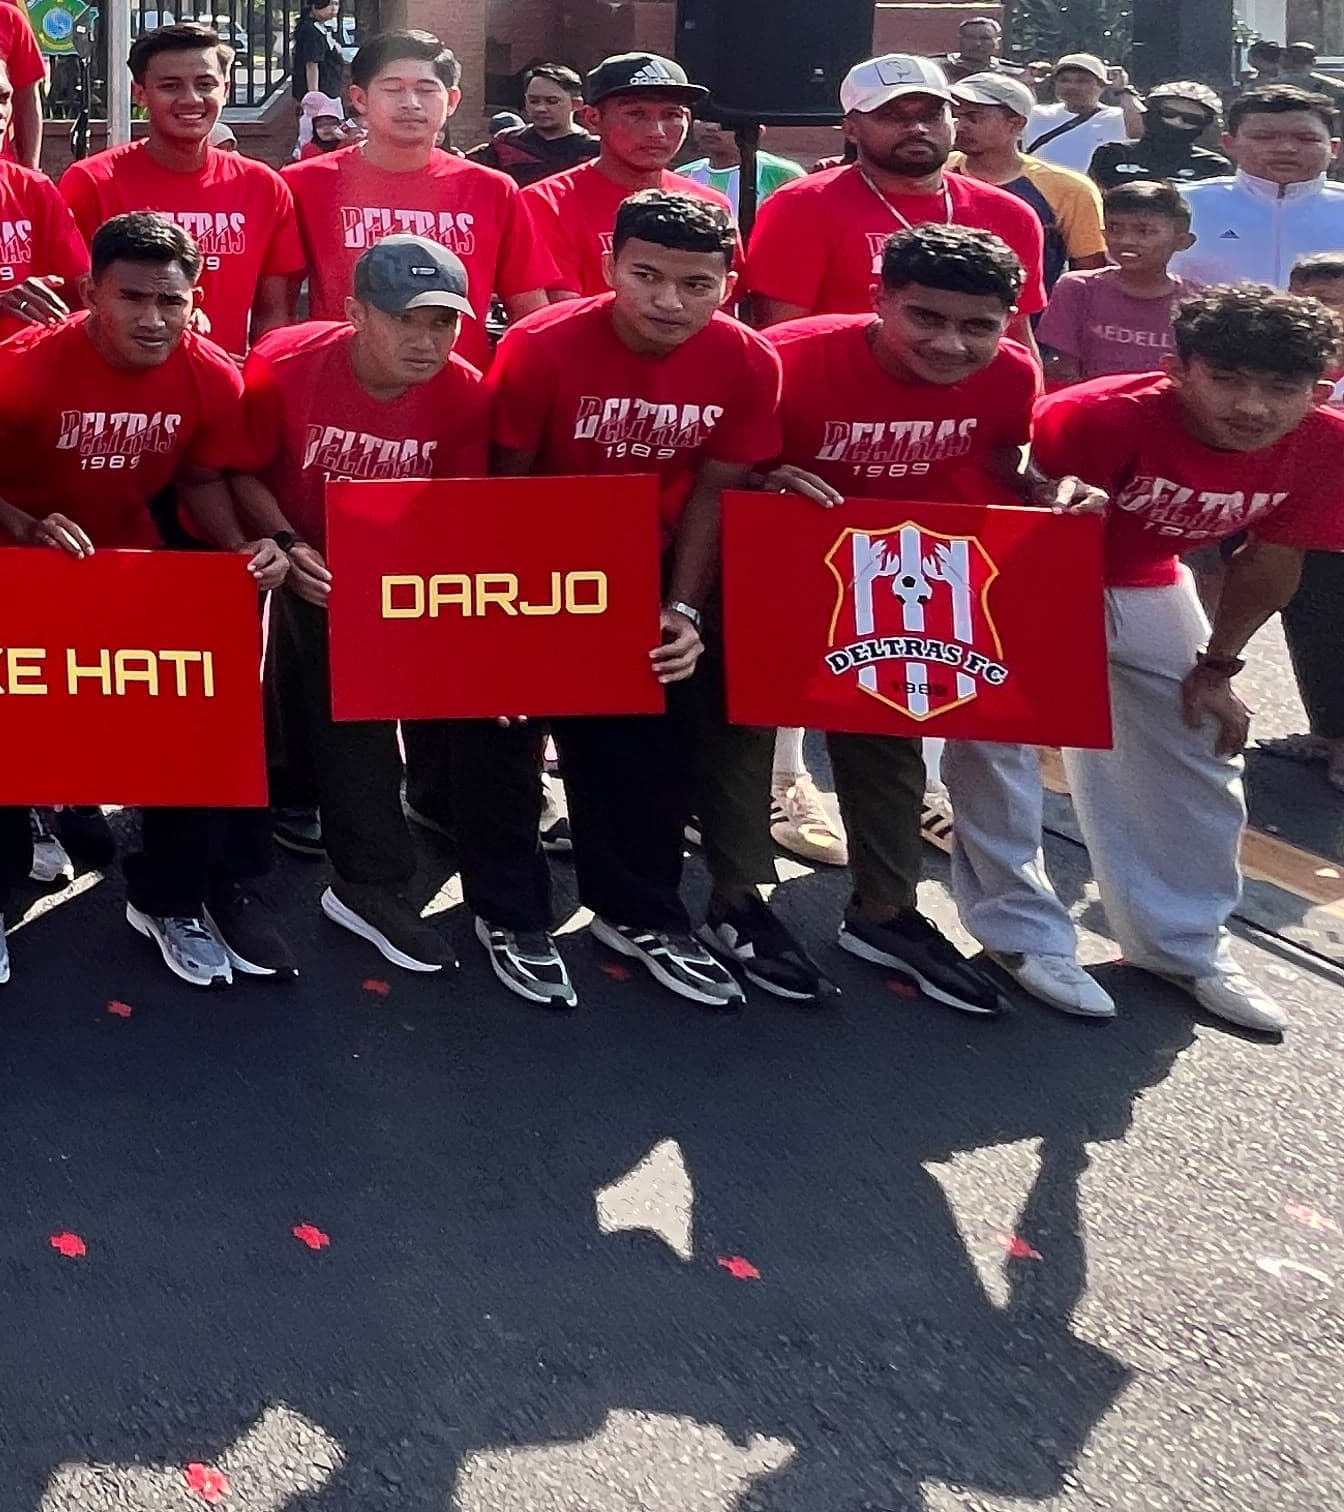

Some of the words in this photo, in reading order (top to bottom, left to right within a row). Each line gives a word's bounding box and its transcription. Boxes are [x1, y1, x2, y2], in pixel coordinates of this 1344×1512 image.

[56, 409, 181, 455] DELTRAS
[574, 394, 724, 450] DELTRAS
[814, 417, 977, 463] DELTRAS
[80, 454, 140, 470] 1989
[605, 445, 676, 461] 1989
[851, 461, 930, 479] 1989
[381, 570, 609, 620] DARJO
[67, 648, 215, 698] HATI
[825, 637, 962, 675] DELTRAS
[964, 650, 1009, 685] FC
